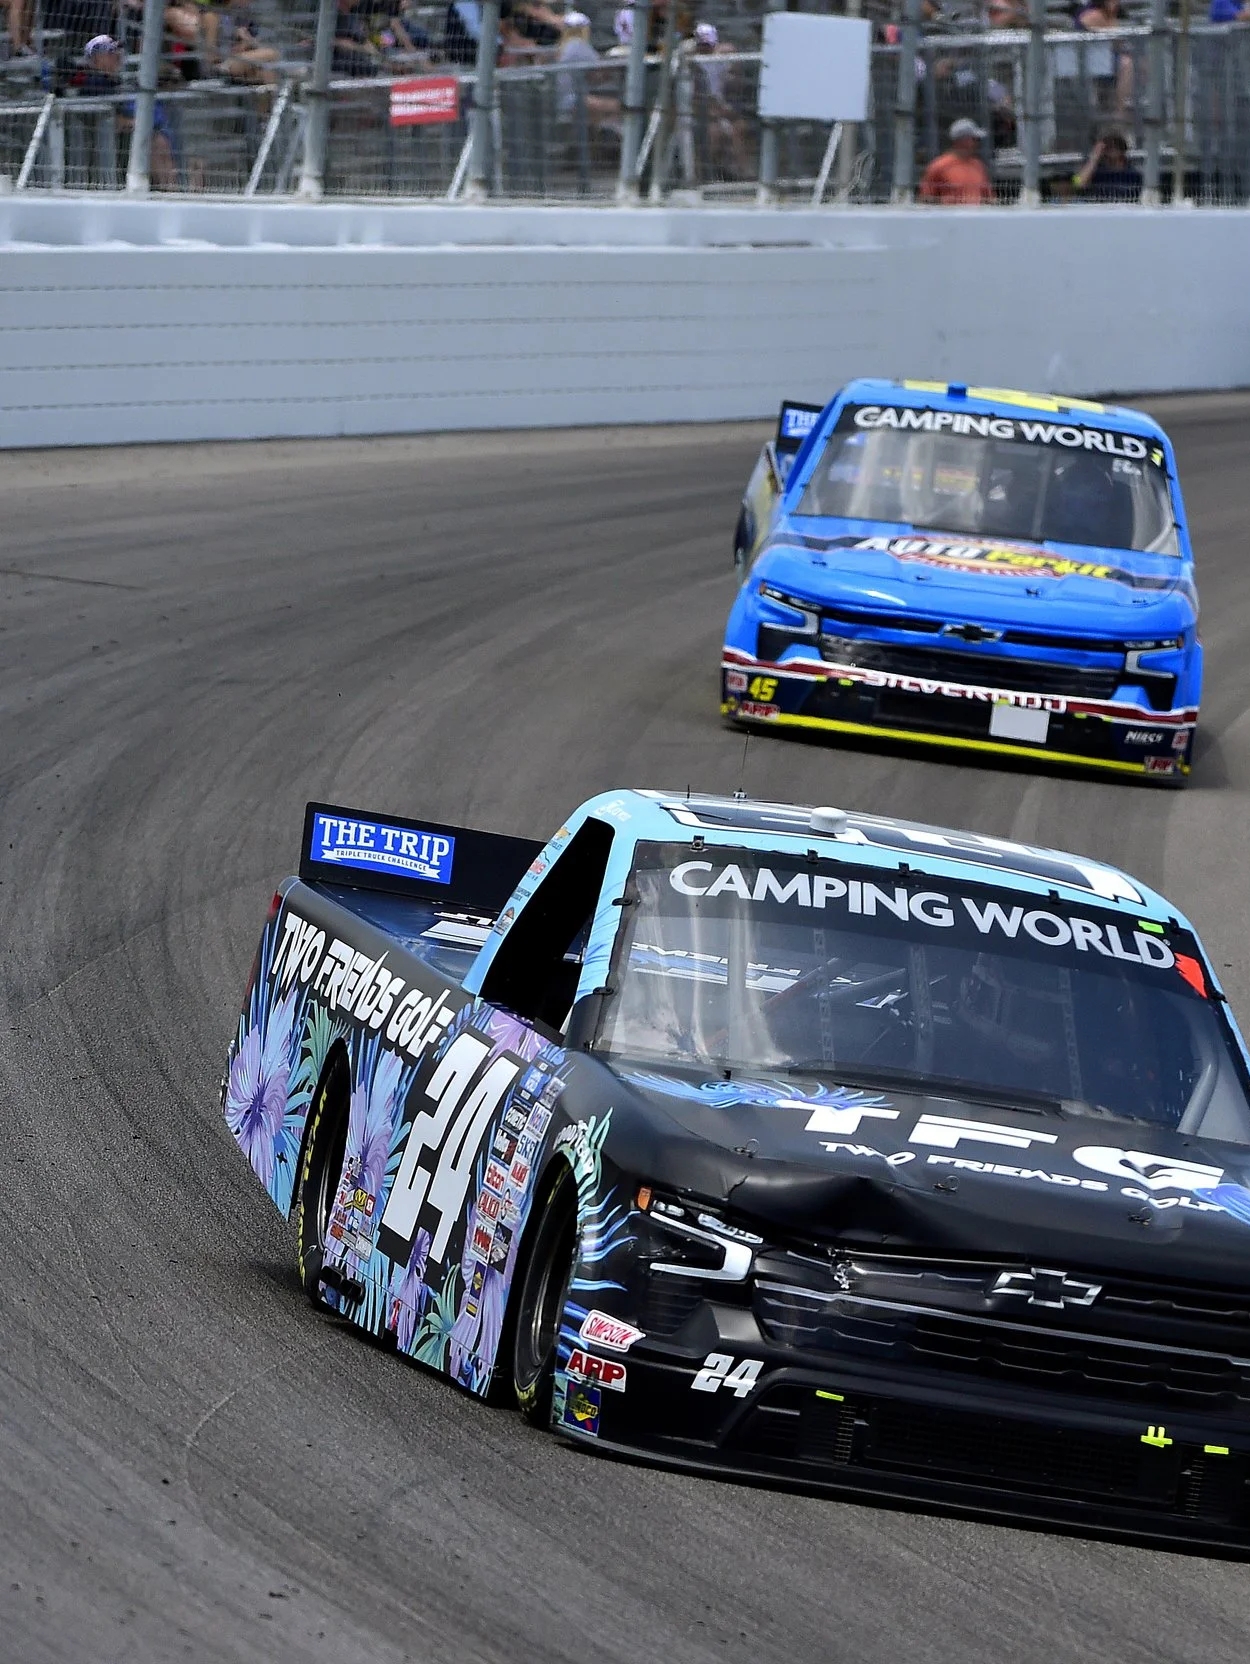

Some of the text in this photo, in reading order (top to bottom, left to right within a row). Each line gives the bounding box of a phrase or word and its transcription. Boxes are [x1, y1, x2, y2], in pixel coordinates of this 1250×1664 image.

[853, 406, 1148, 459] CAMPING WORLD
[748, 676, 779, 702] 45
[319, 816, 450, 867] THE TRIP
[336, 849, 427, 872] TRIPLE TRUCK CHALLENGE
[669, 862, 1176, 969] CAMPING WORLD
[271, 911, 456, 1058] TWO FRIENDS GOLF
[381, 1032, 520, 1265] 24
[517, 1134, 536, 1160] SKF
[776, 1099, 1225, 1190] TFG
[819, 1141, 1226, 1213] TWO FRIENDS GOLF
[586, 1316, 636, 1345] SIMPSON
[567, 1350, 625, 1384] ARP
[690, 1352, 765, 1398] 24
